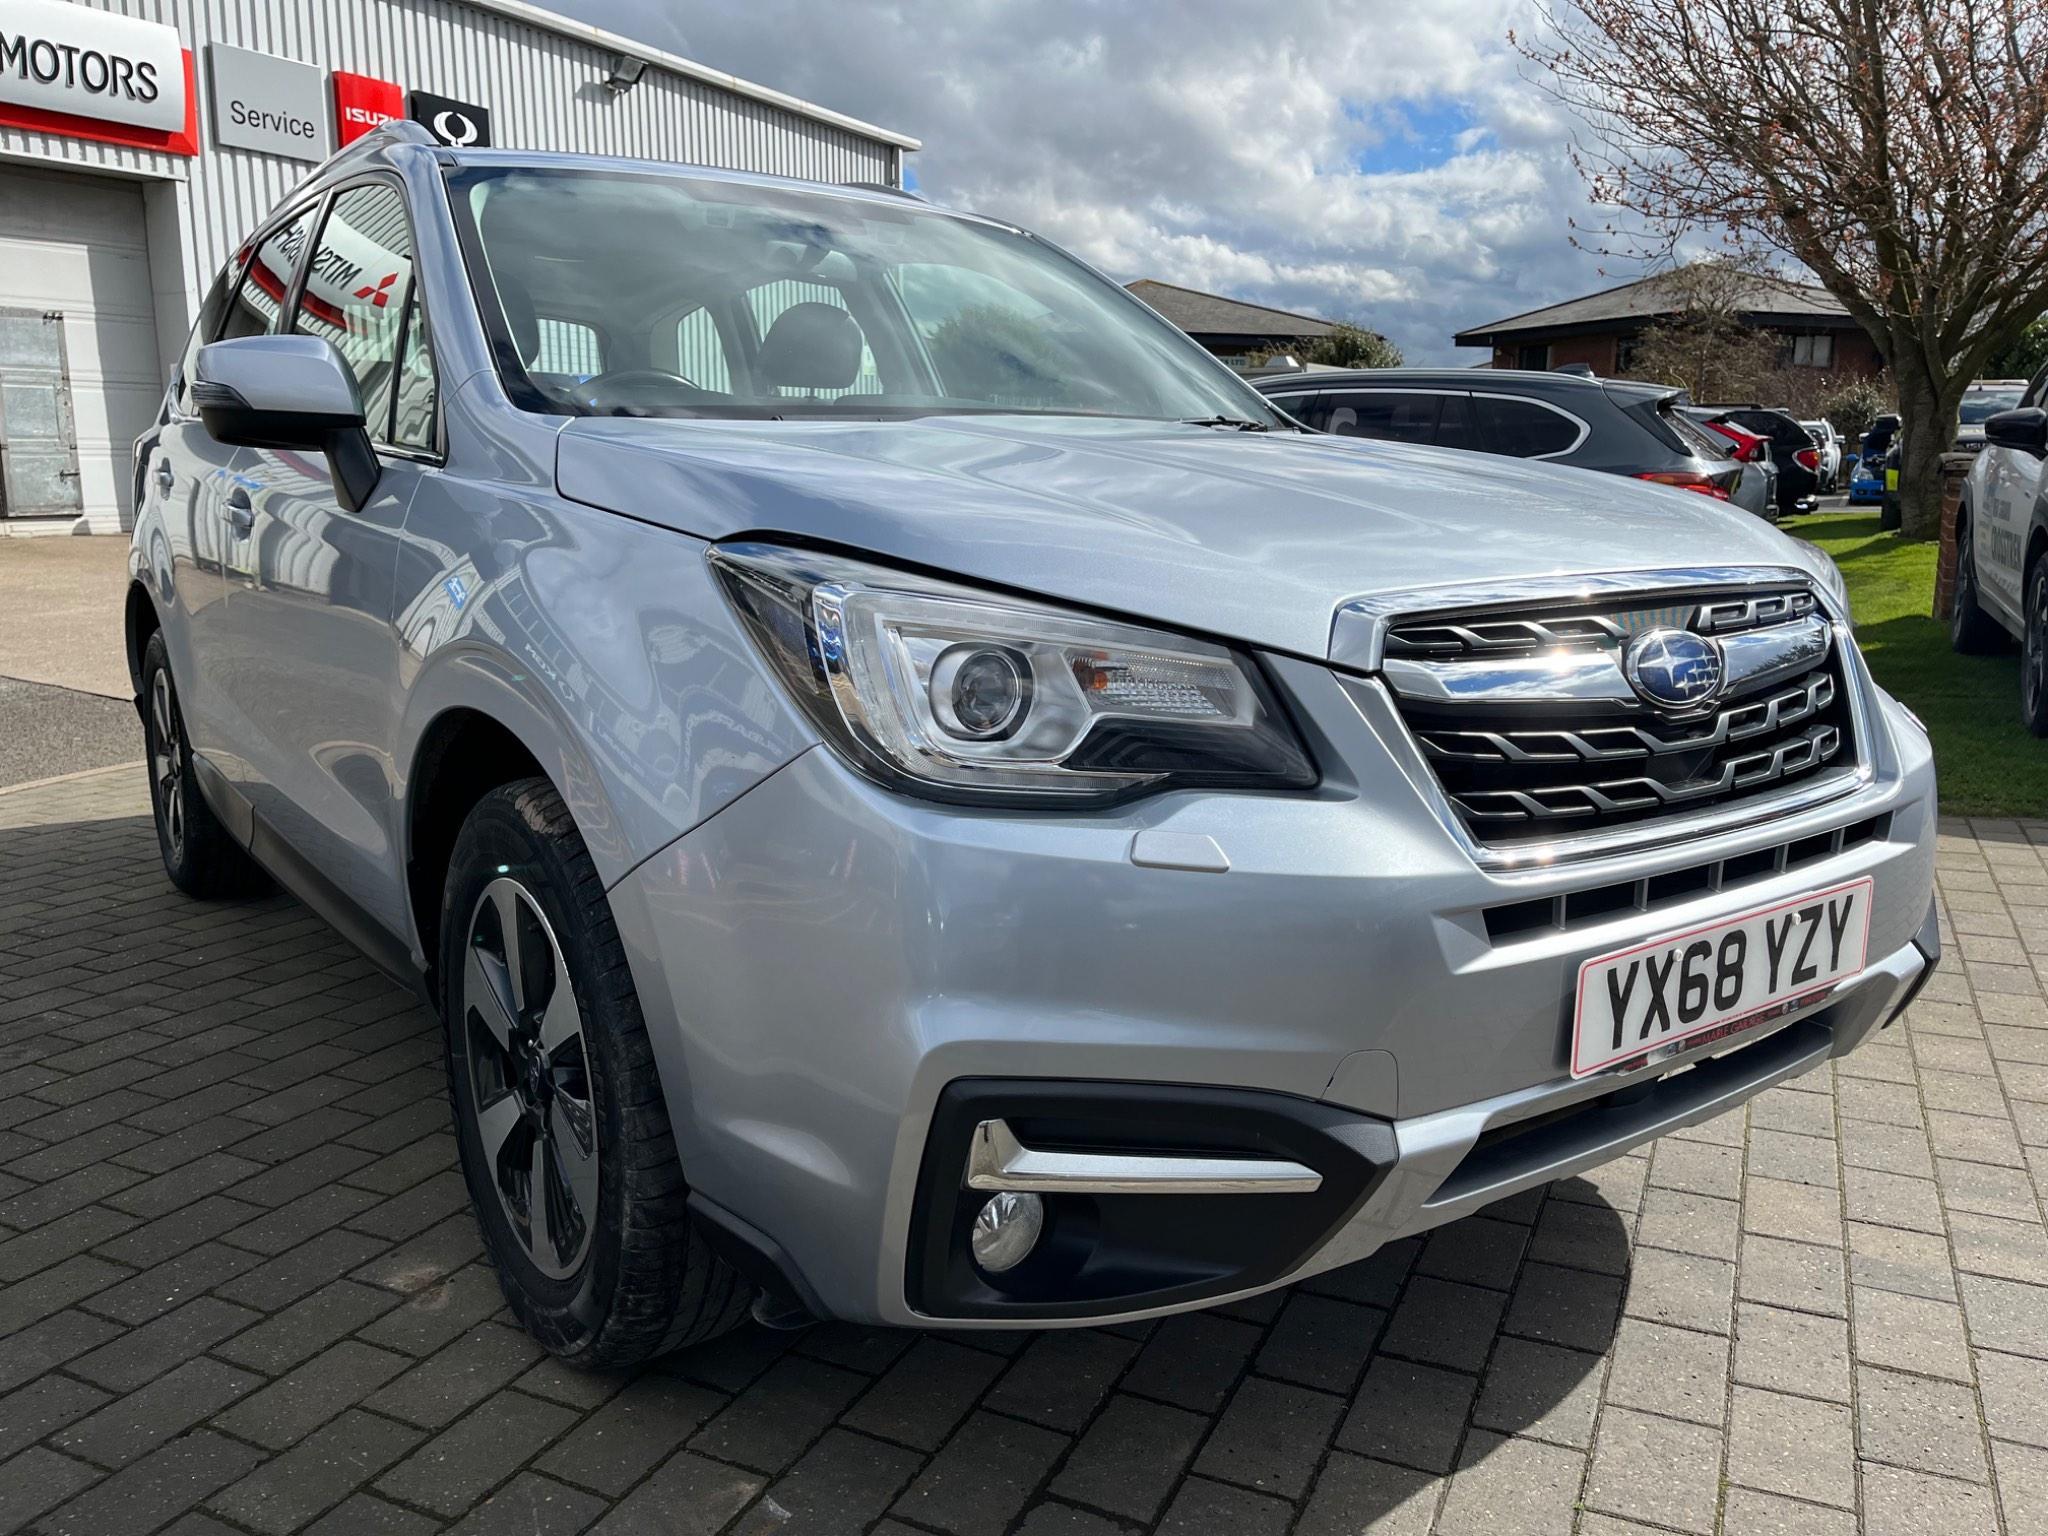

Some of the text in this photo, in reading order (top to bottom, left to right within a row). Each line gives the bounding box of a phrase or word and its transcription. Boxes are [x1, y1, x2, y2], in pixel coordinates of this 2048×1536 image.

[0, 31, 159, 103] MOTORS
[230, 100, 315, 139] Service
[1606, 894, 1855, 1051] YX68 YZY
